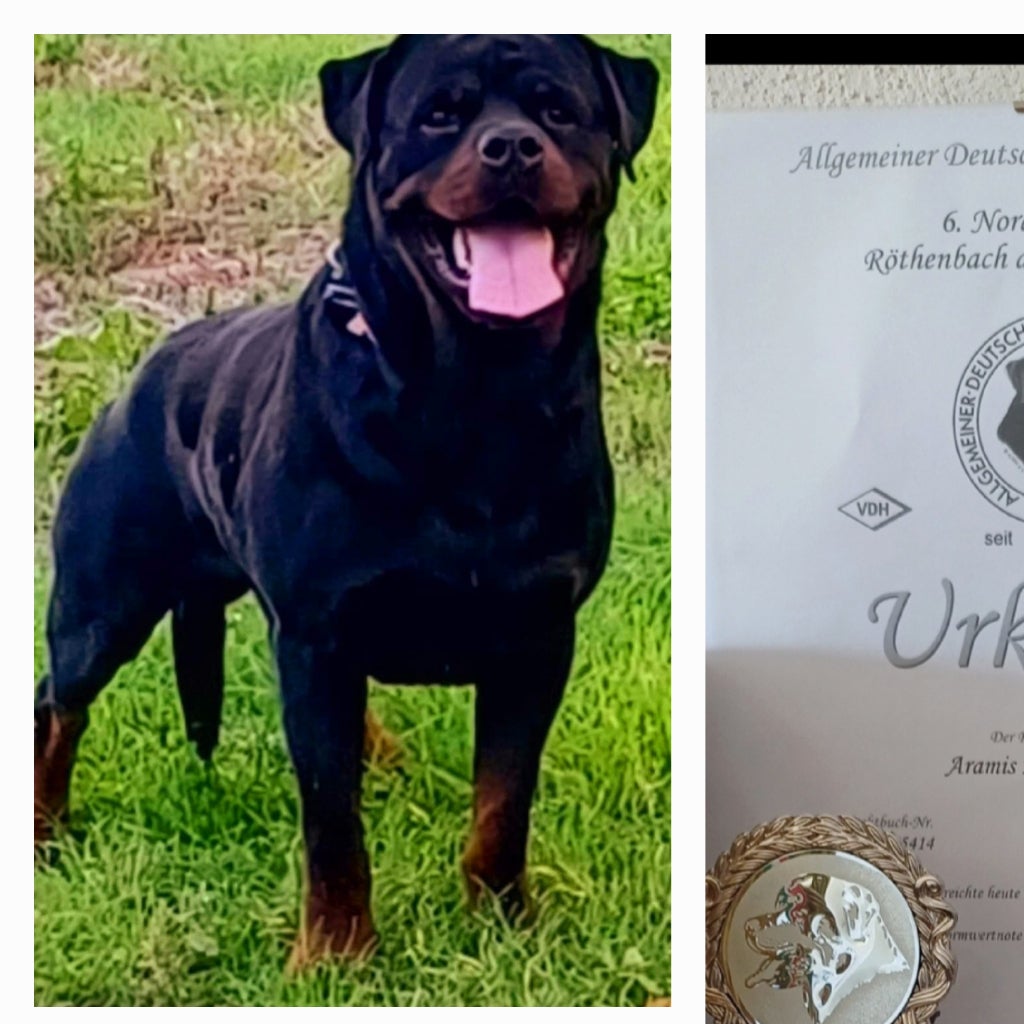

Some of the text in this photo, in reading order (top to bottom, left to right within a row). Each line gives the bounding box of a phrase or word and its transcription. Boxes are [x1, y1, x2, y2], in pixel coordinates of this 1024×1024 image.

[789, 142, 940, 178] Allgemeiner
[943, 210, 961, 233] 6.
[864, 243, 1008, 275] Röthenbach
[857, 502, 889, 517] VDH
[985, 530, 1013, 546] seit
[990, 731, 1015, 744] Der
[944, 755, 1018, 777] Aramis
[988, 887, 1020, 900] heute
